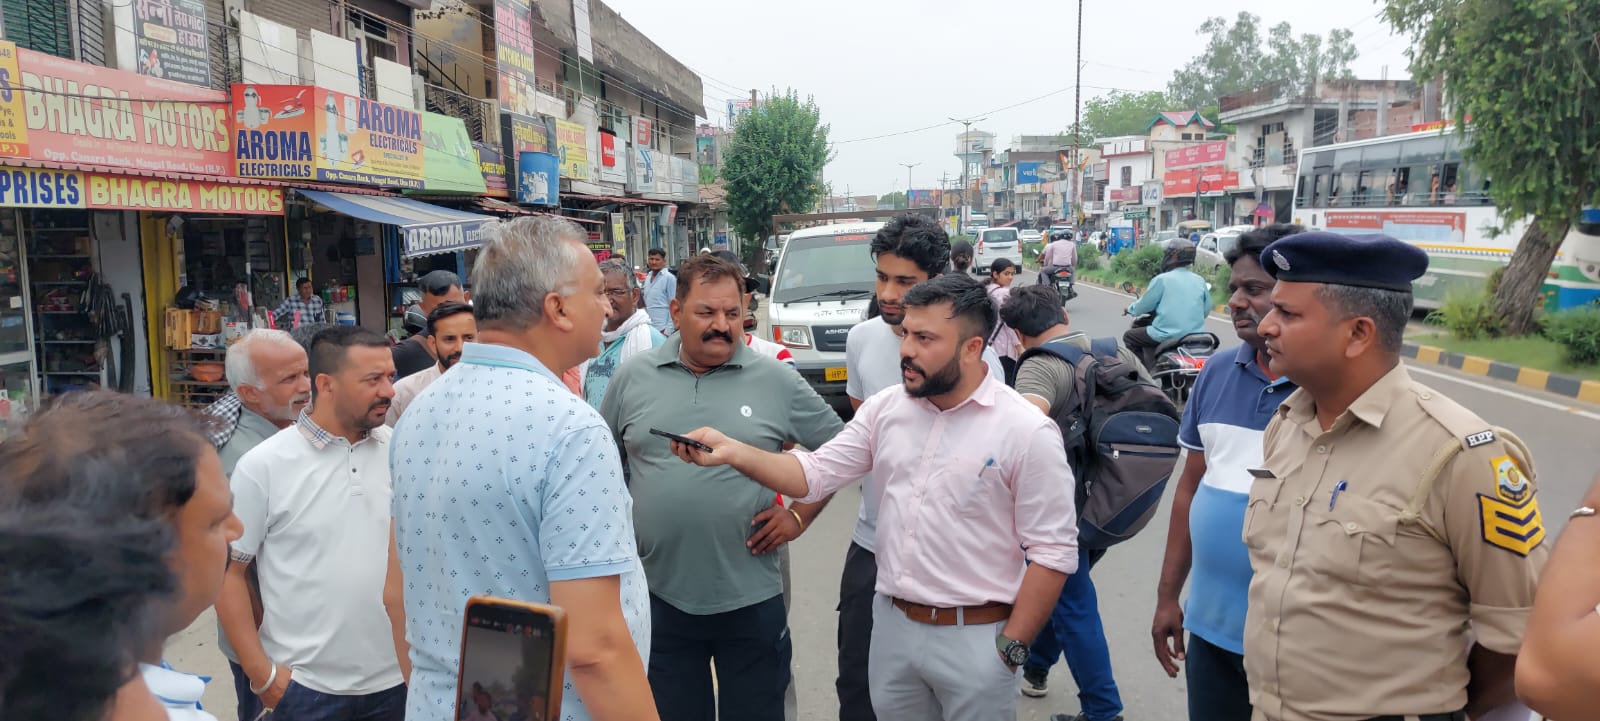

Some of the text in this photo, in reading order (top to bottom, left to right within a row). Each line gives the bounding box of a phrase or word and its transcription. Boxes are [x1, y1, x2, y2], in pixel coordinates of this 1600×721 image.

[21, 71, 230, 153] BHAGRA MOTORS
[358, 99, 421, 141] AROMA
[237, 130, 312, 161] AROMA
[369, 133, 417, 154] ELECTRICALS
[239, 162, 311, 177] ELECTRICALS
[0, 169, 80, 205] PRISES
[90, 176, 283, 212] BHAGRA MOTORS
[408, 224, 465, 251] AROMA
[1467, 431, 1493, 446] HPP
